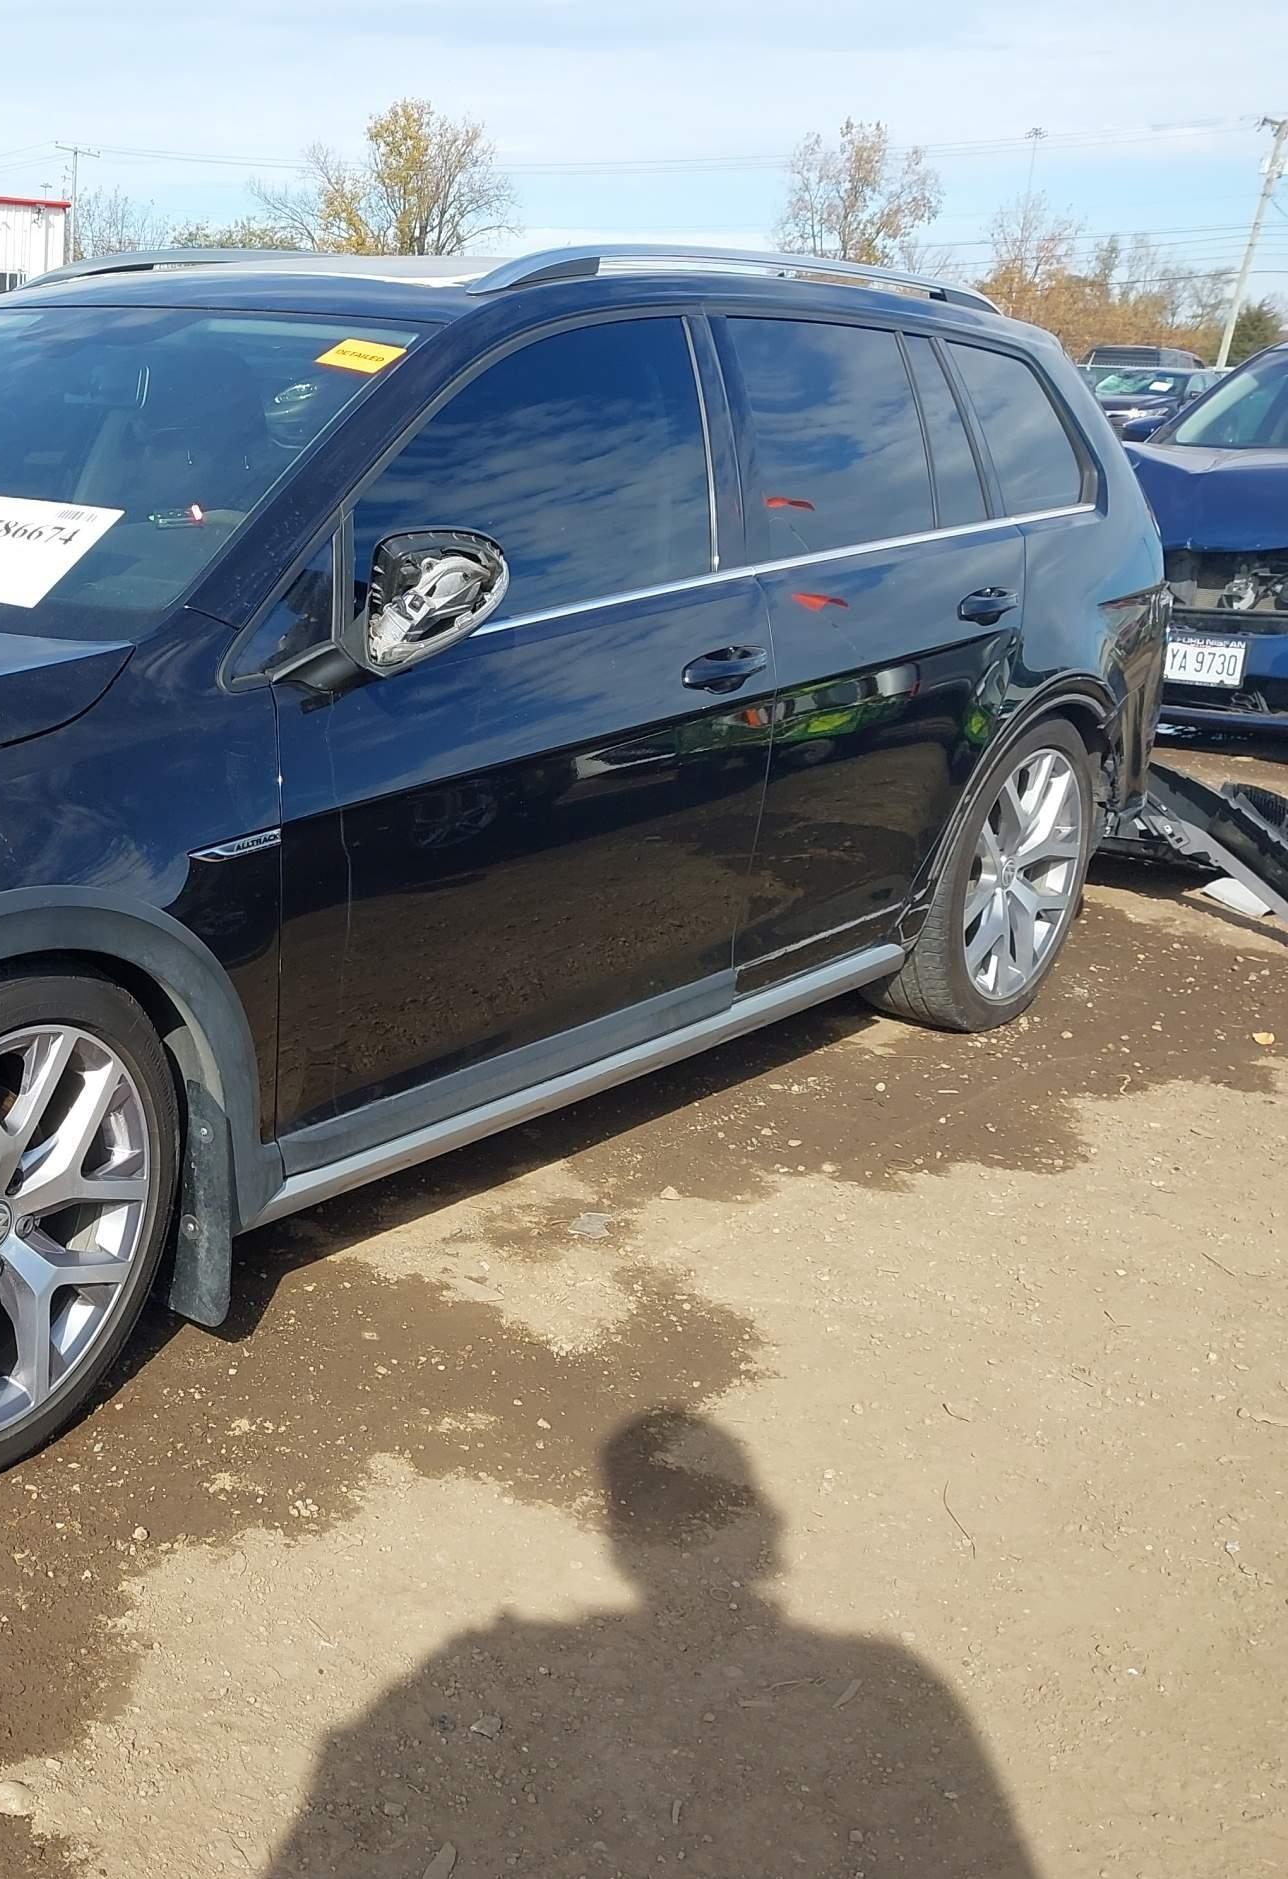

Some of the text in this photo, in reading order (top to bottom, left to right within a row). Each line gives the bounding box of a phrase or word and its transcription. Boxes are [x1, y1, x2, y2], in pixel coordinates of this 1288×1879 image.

[335, 348, 385, 362] DETAILED
[1206, 639, 1246, 649] NISSAN
[1194, 651, 1238, 677] 9730
[235, 832, 280, 851] ALLTRACK
